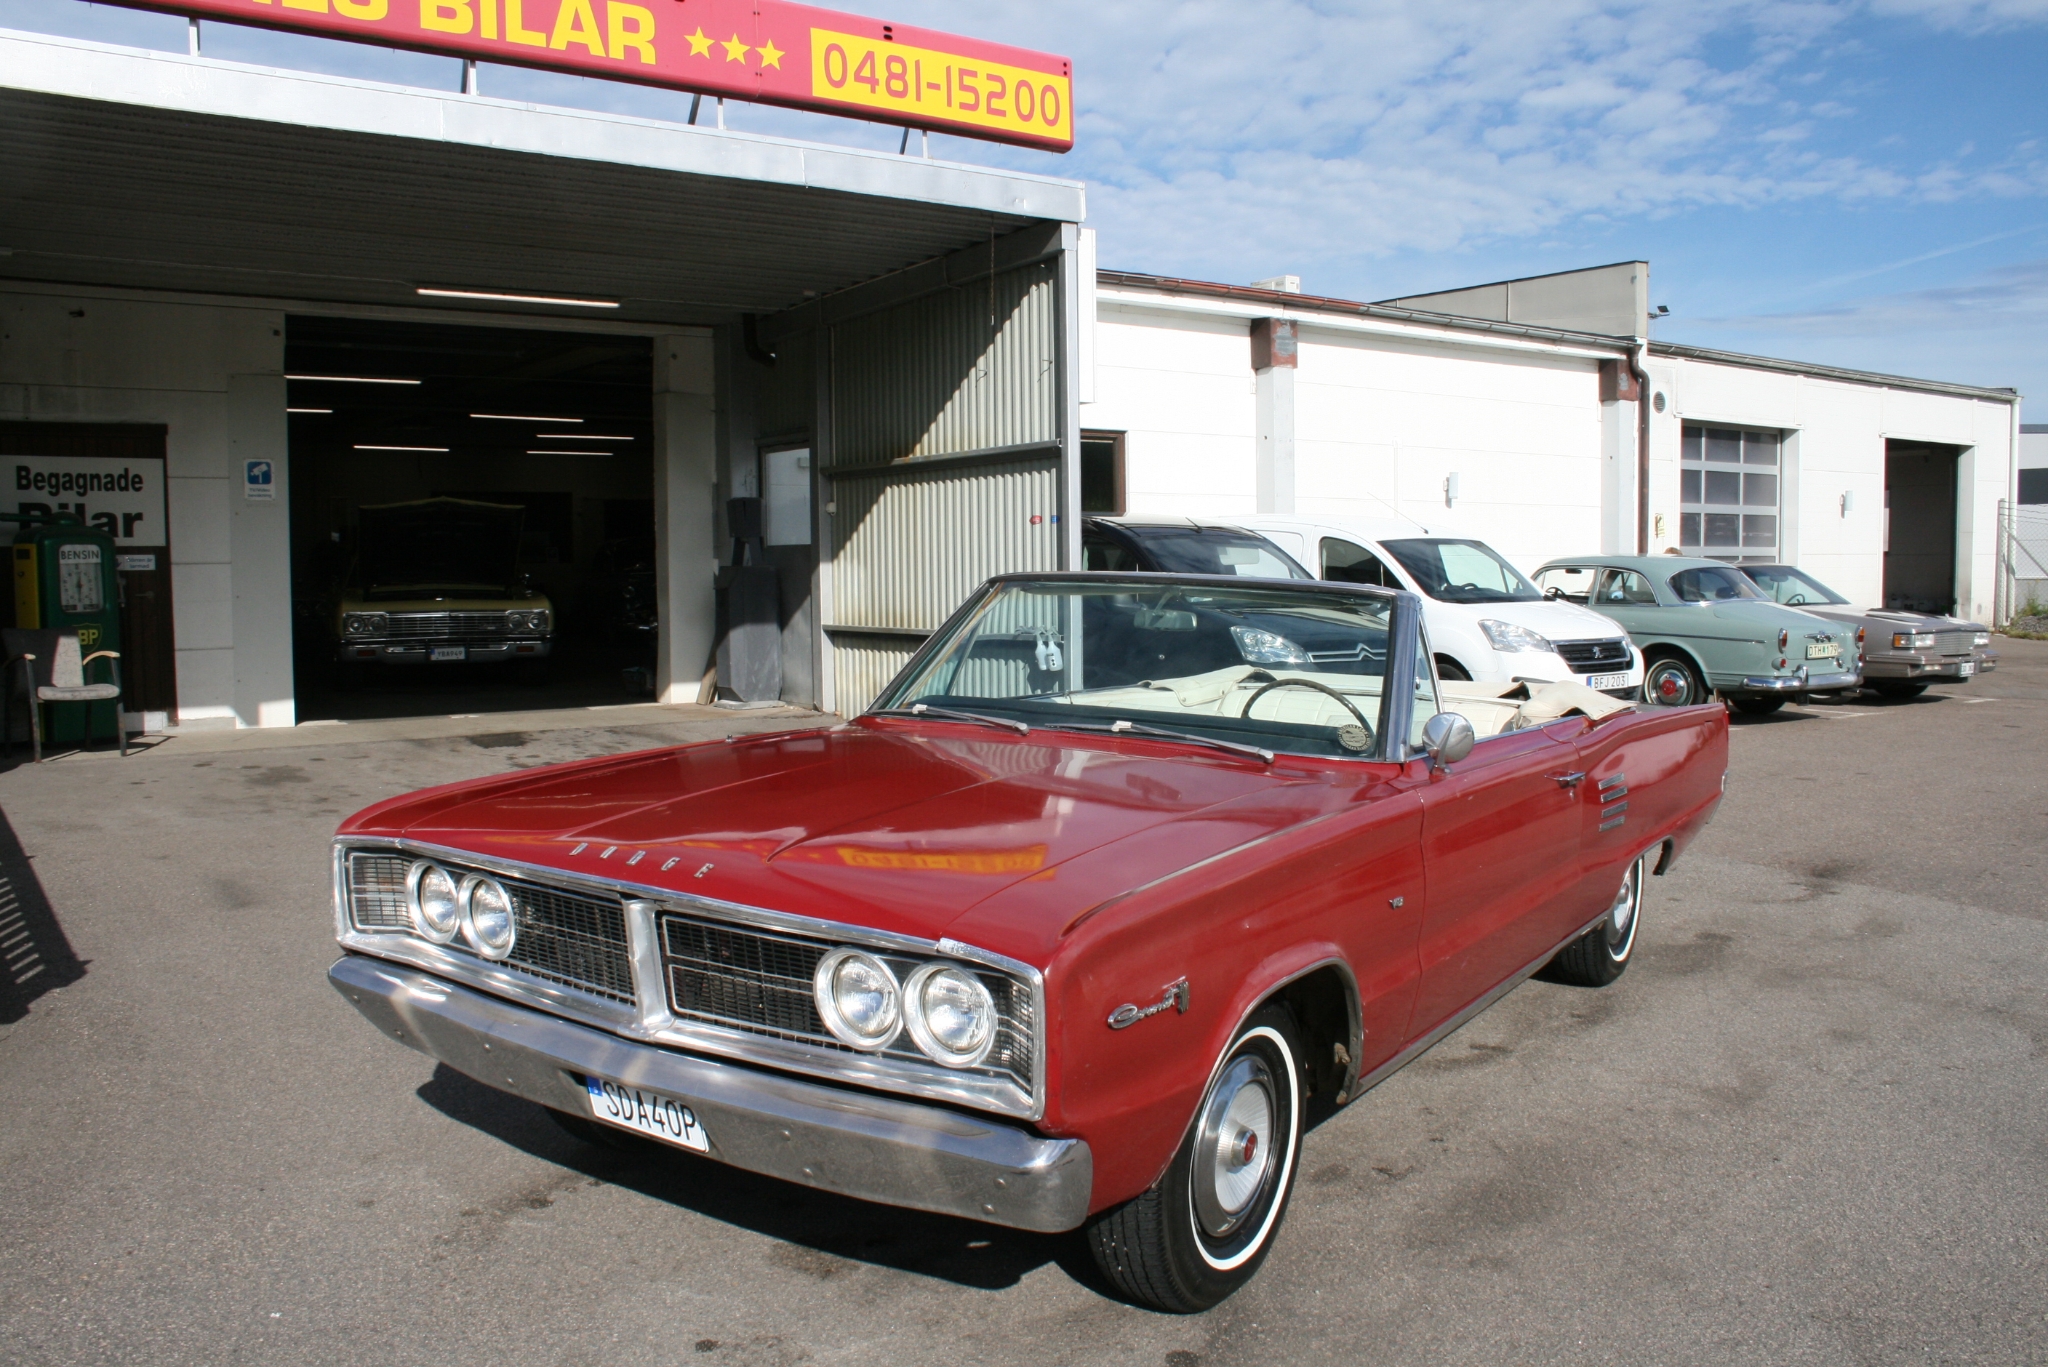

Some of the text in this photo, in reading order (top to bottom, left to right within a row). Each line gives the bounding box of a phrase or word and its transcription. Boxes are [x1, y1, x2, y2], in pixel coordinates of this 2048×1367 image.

[420, 0, 656, 65] BILAR
[824, 42, 1061, 127] 0481-15200
[15, 465, 144, 497] Begagnade
[18, 502, 144, 538] Blar
[60, 549, 100, 560] BENSIN
[77, 629, 99, 646] BP
